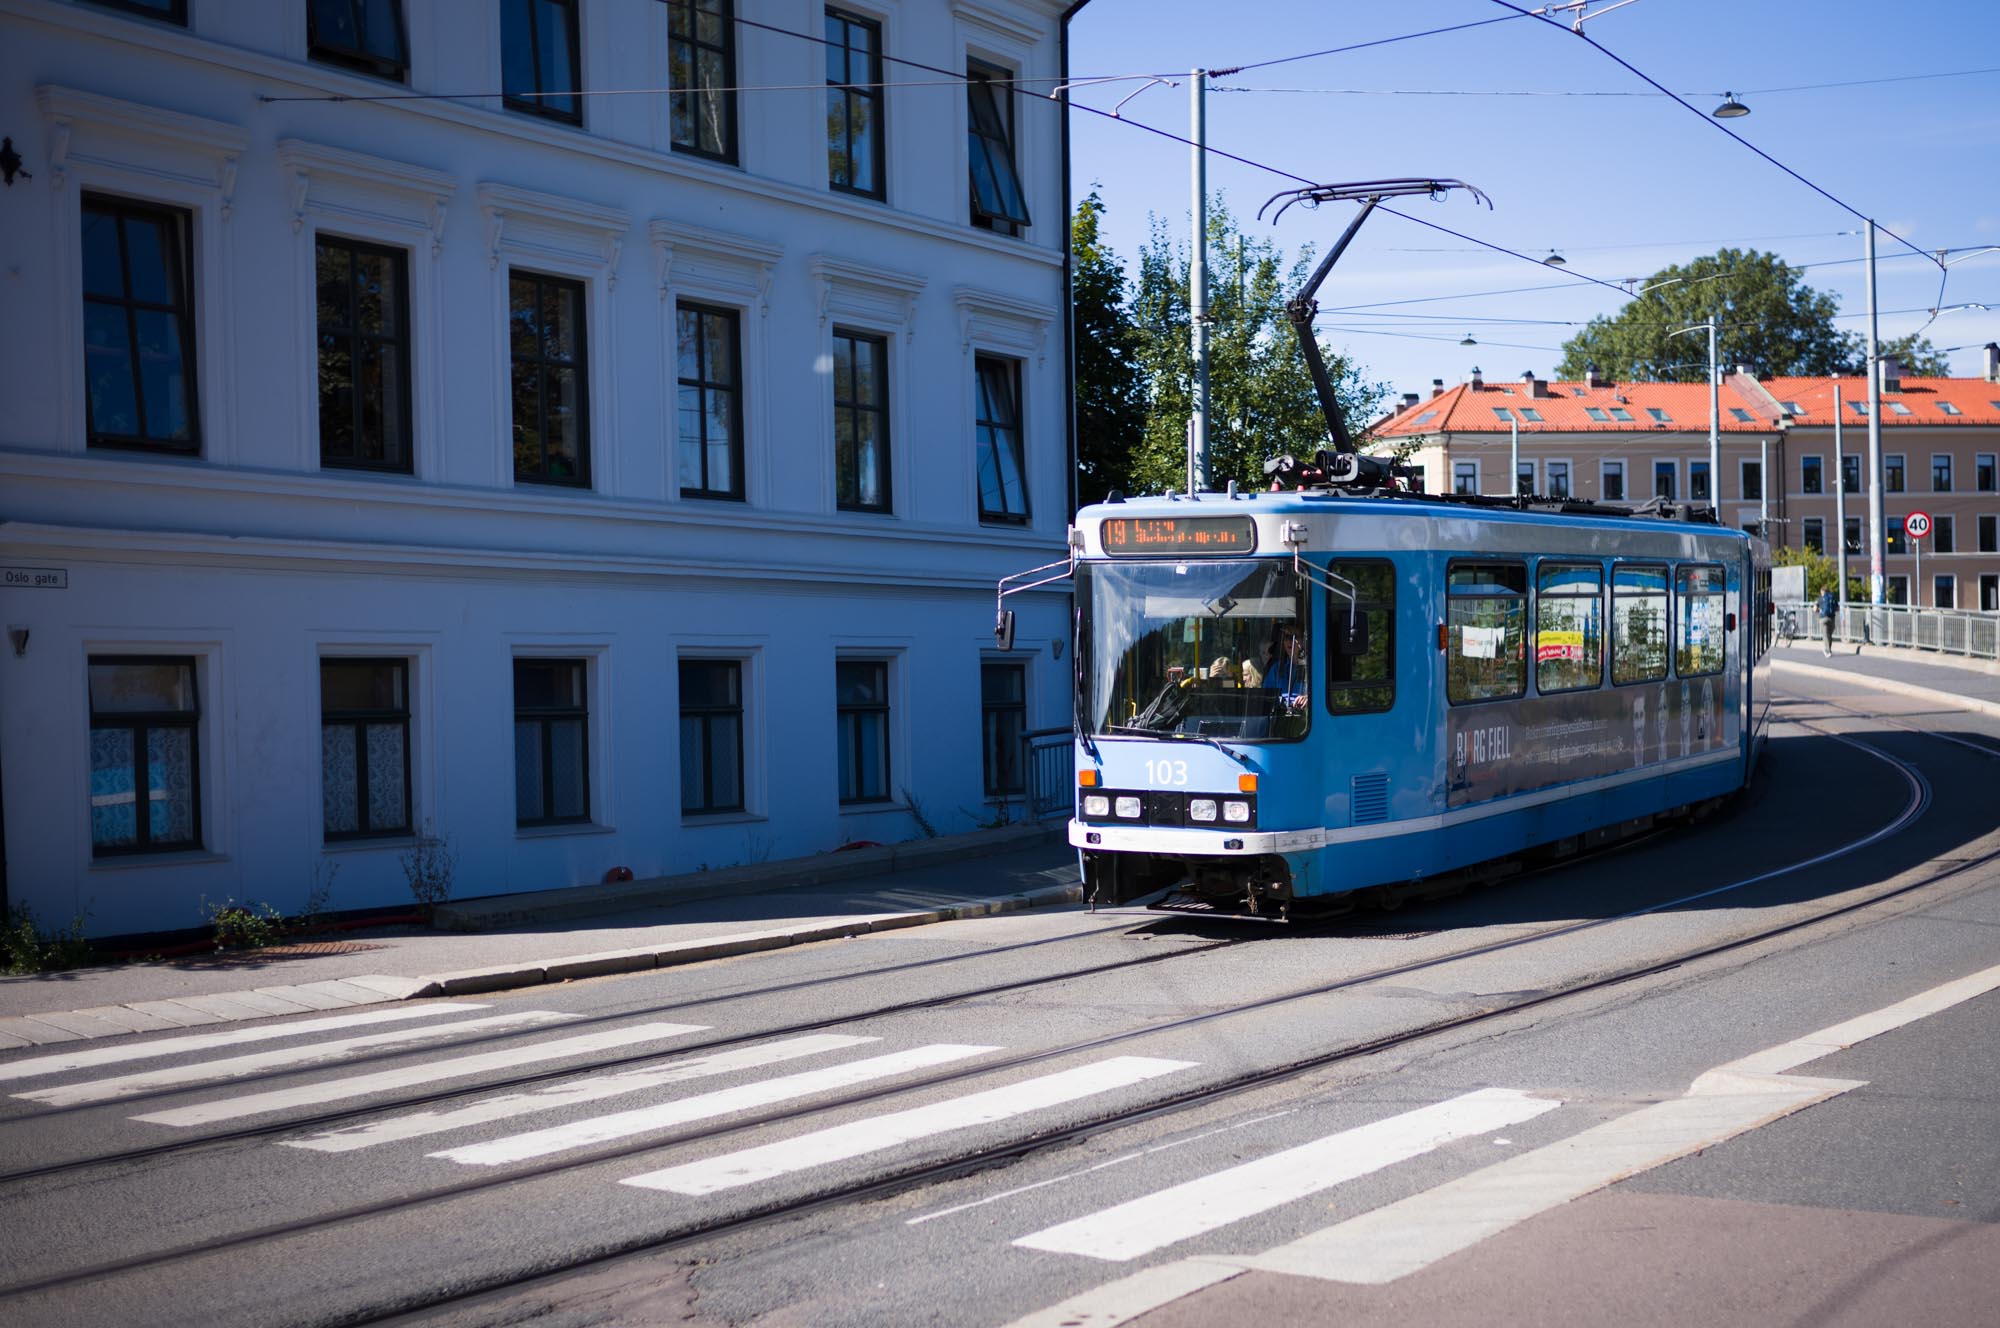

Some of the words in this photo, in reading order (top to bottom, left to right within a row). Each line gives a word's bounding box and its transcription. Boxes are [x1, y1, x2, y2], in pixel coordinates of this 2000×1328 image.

[1909, 518, 1928, 531] 40
[6, 571, 29, 583] Oslo
[35, 574, 58, 586] gate
[1488, 726, 1511, 761] FJELL
[1145, 759, 1188, 785] 103
